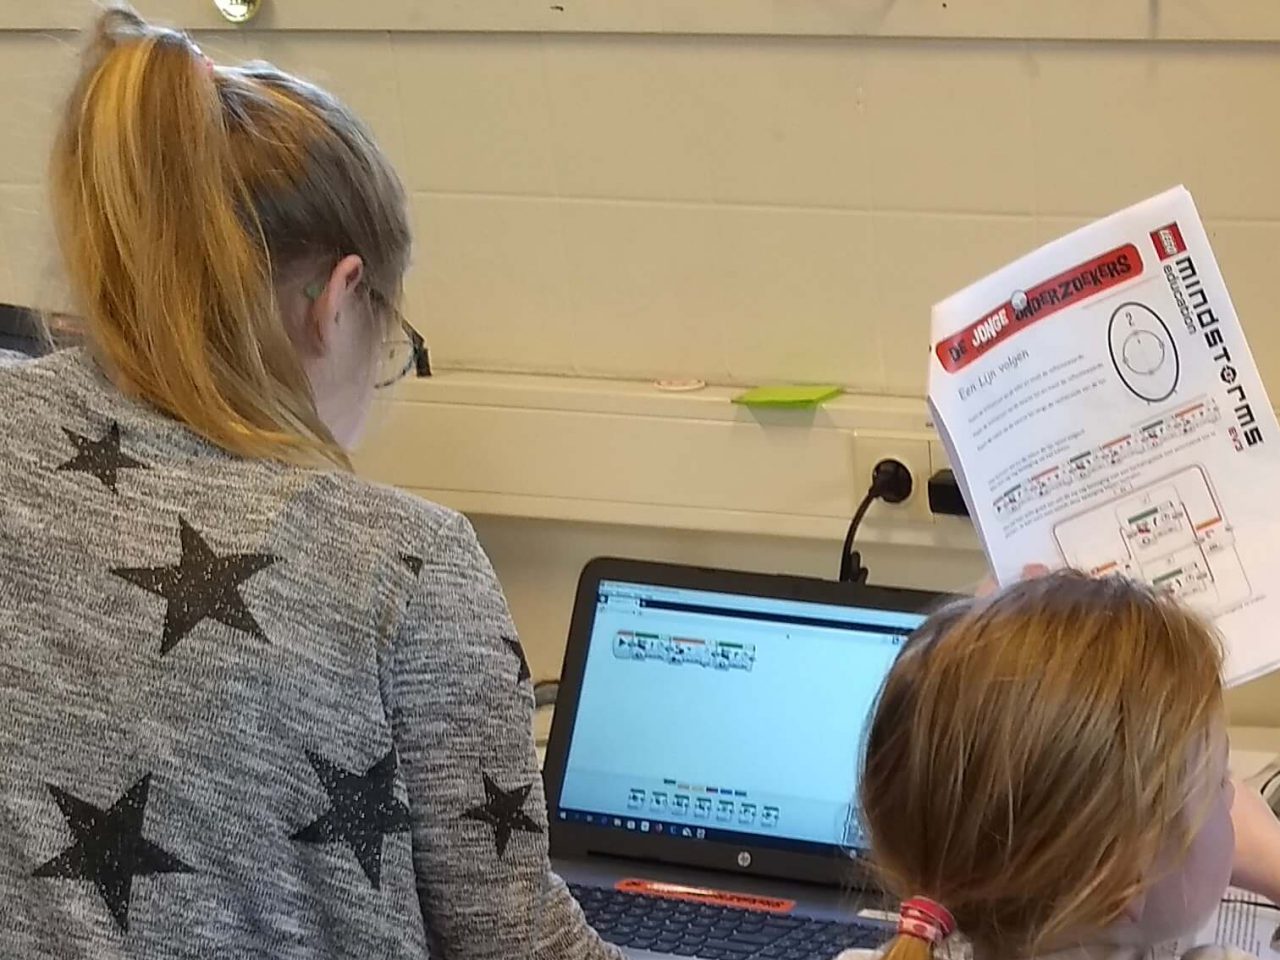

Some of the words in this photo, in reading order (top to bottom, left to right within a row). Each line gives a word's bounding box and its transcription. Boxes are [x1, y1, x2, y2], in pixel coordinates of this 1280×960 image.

[1163, 264, 1197, 335] education
[949, 340, 967, 362] DE
[971, 308, 1010, 347] JONGE
[957, 382, 977, 401] Een
[999, 349, 1030, 374] volgen
[1228, 426, 1244, 452] EV3
